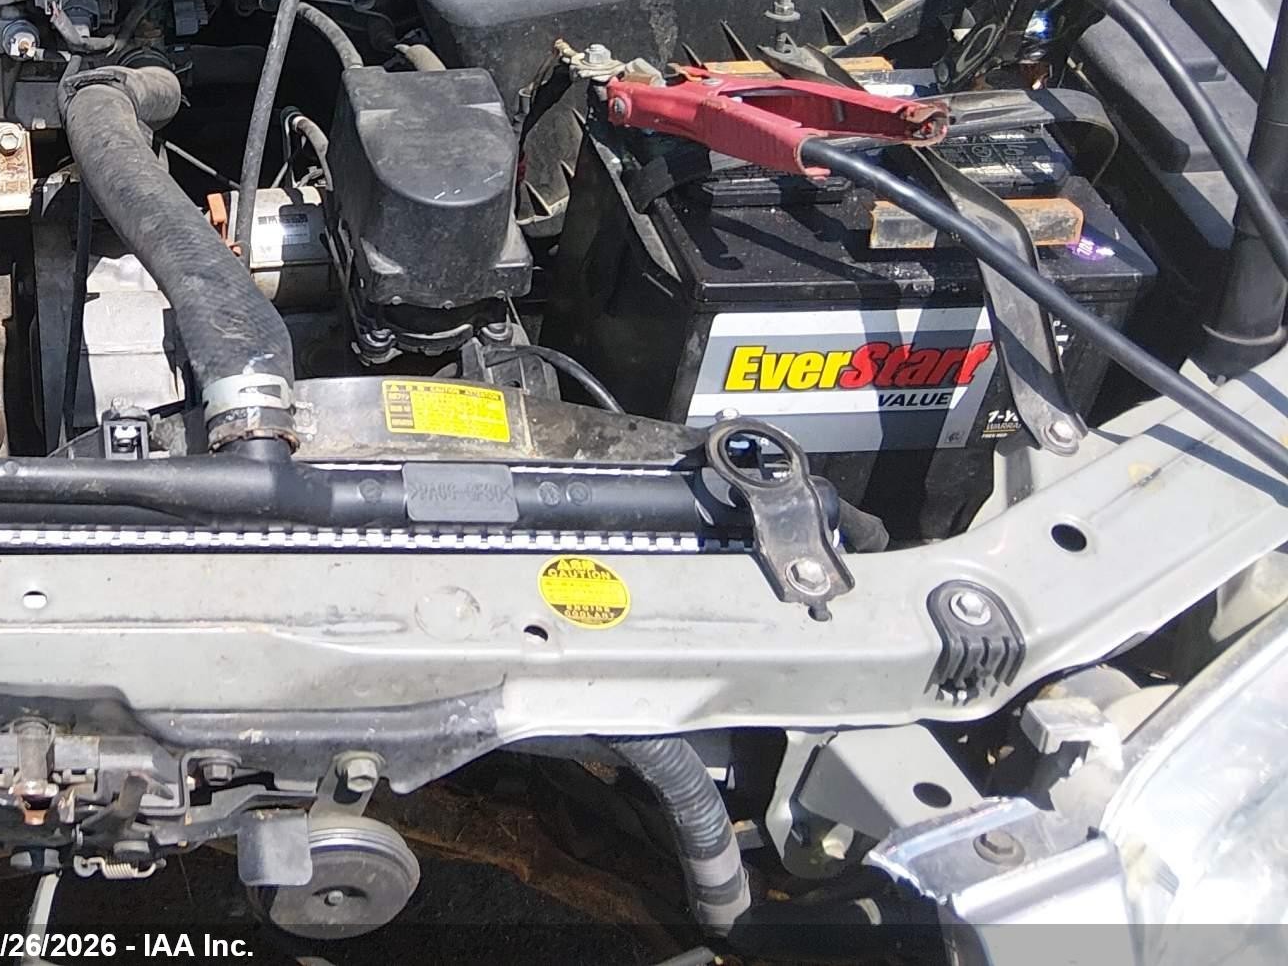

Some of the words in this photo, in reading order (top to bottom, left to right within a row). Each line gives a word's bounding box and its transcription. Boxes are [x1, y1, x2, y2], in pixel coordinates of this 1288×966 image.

[724, 341, 994, 392] EverStart
[878, 392, 953, 407] VALUE
[547, 568, 611, 580] CAUTION
